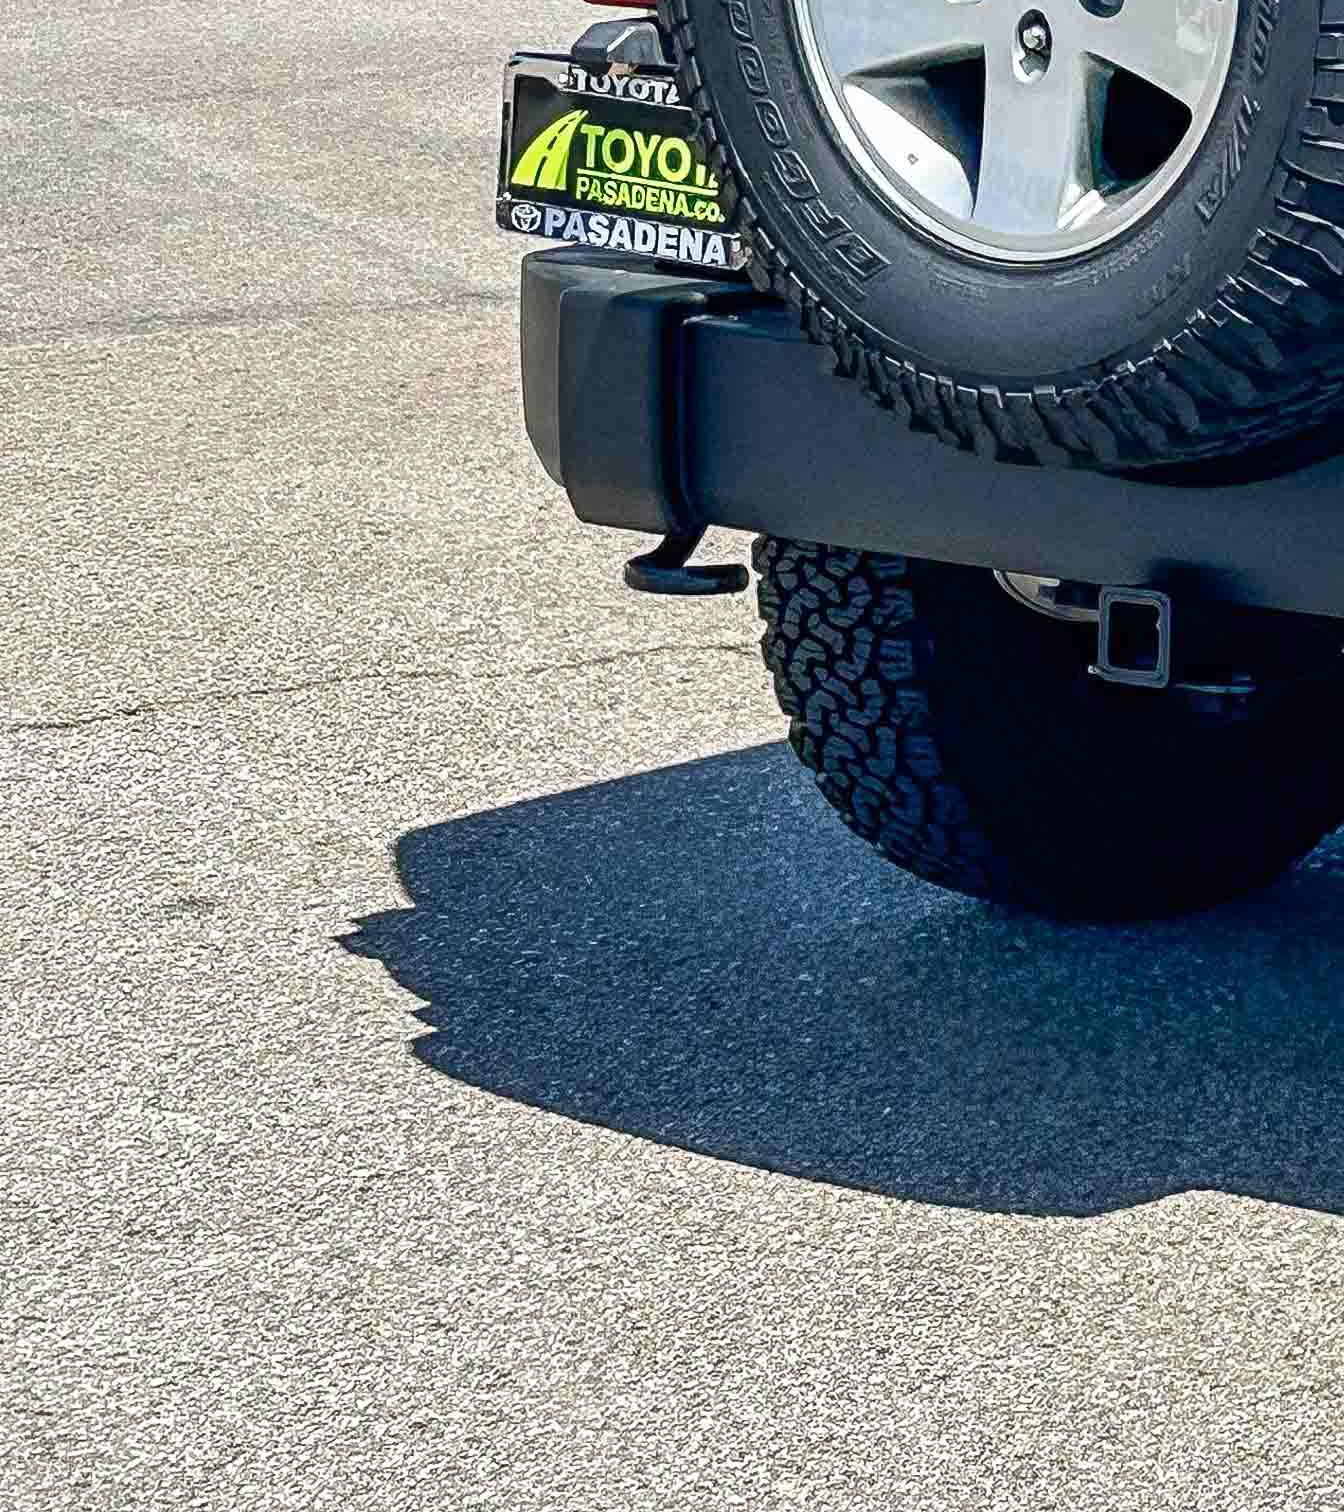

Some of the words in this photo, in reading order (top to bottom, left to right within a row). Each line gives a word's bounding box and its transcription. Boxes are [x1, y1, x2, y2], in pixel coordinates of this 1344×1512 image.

[580, 124, 720, 188] TOYO
[575, 175, 726, 223] PASADENA.CO
[543, 207, 727, 266] PASADENA
